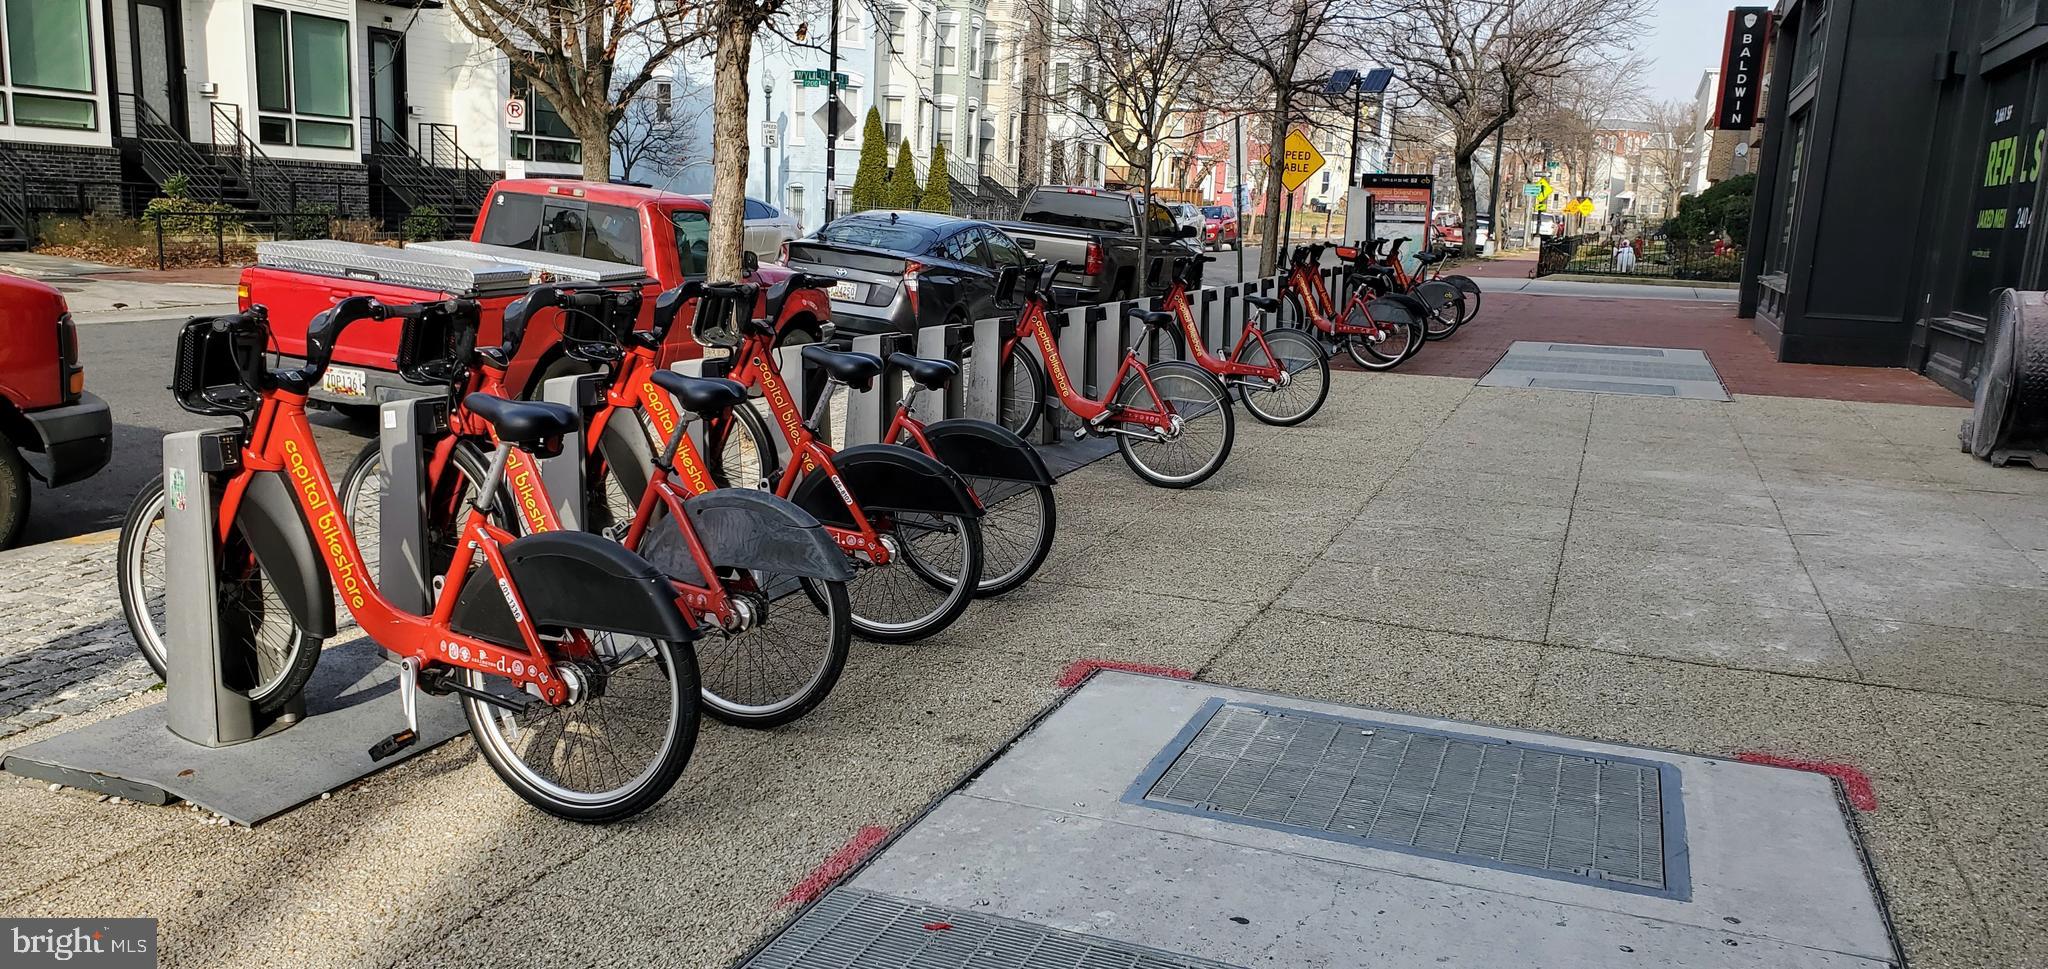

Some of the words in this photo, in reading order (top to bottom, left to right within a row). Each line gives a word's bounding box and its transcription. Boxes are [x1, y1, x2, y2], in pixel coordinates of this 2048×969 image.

[1731, 33, 1753, 123] BALDWIN
[765, 134, 775, 145] 15
[1285, 150, 1312, 160] PEED
[1984, 136, 2030, 187] RETAL
[1284, 163, 1309, 173] ABLE
[1037, 320, 1054, 353] capital
[1048, 352, 1070, 398] bikeshare
[759, 362, 789, 409] capital
[284, 439, 328, 511] capital
[318, 510, 365, 609] bikeshare
